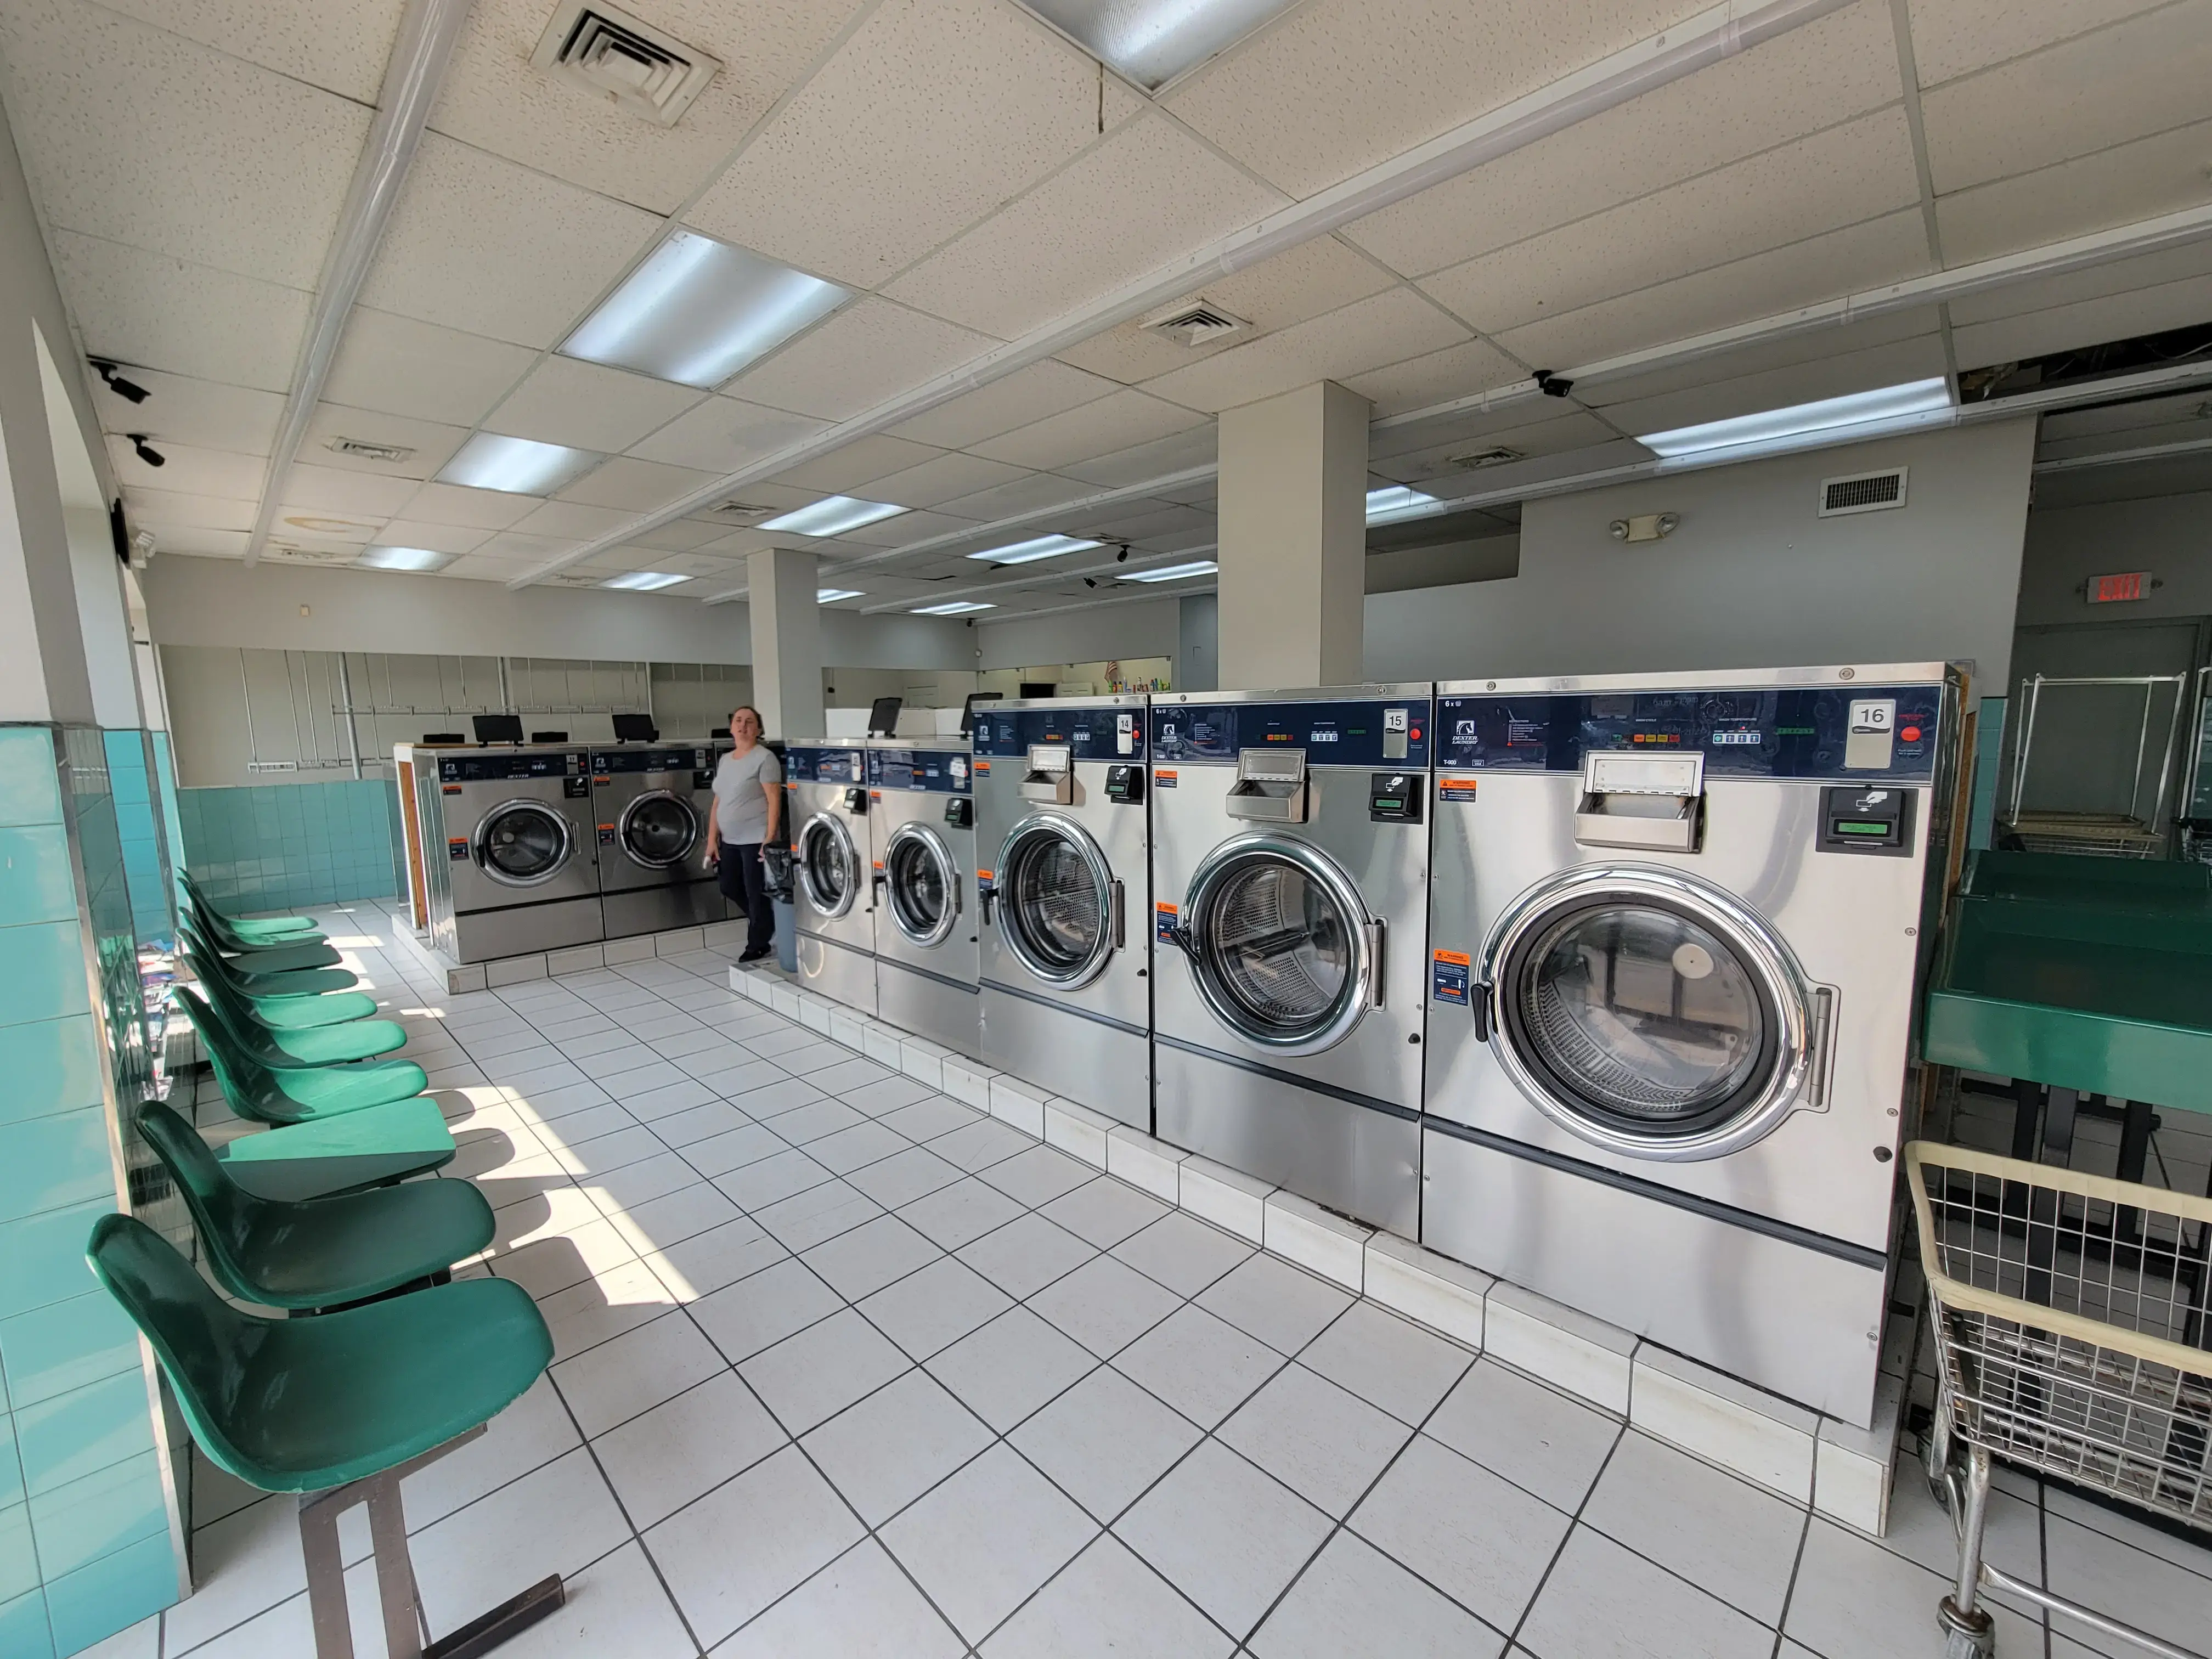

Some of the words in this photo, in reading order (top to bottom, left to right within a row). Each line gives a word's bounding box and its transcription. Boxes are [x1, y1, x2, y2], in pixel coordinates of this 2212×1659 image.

[2098, 573, 2142, 601] EXIT
[1389, 715, 1402, 726] 15
[1861, 709, 1884, 723] 16
[1121, 720, 1128, 728] 14
